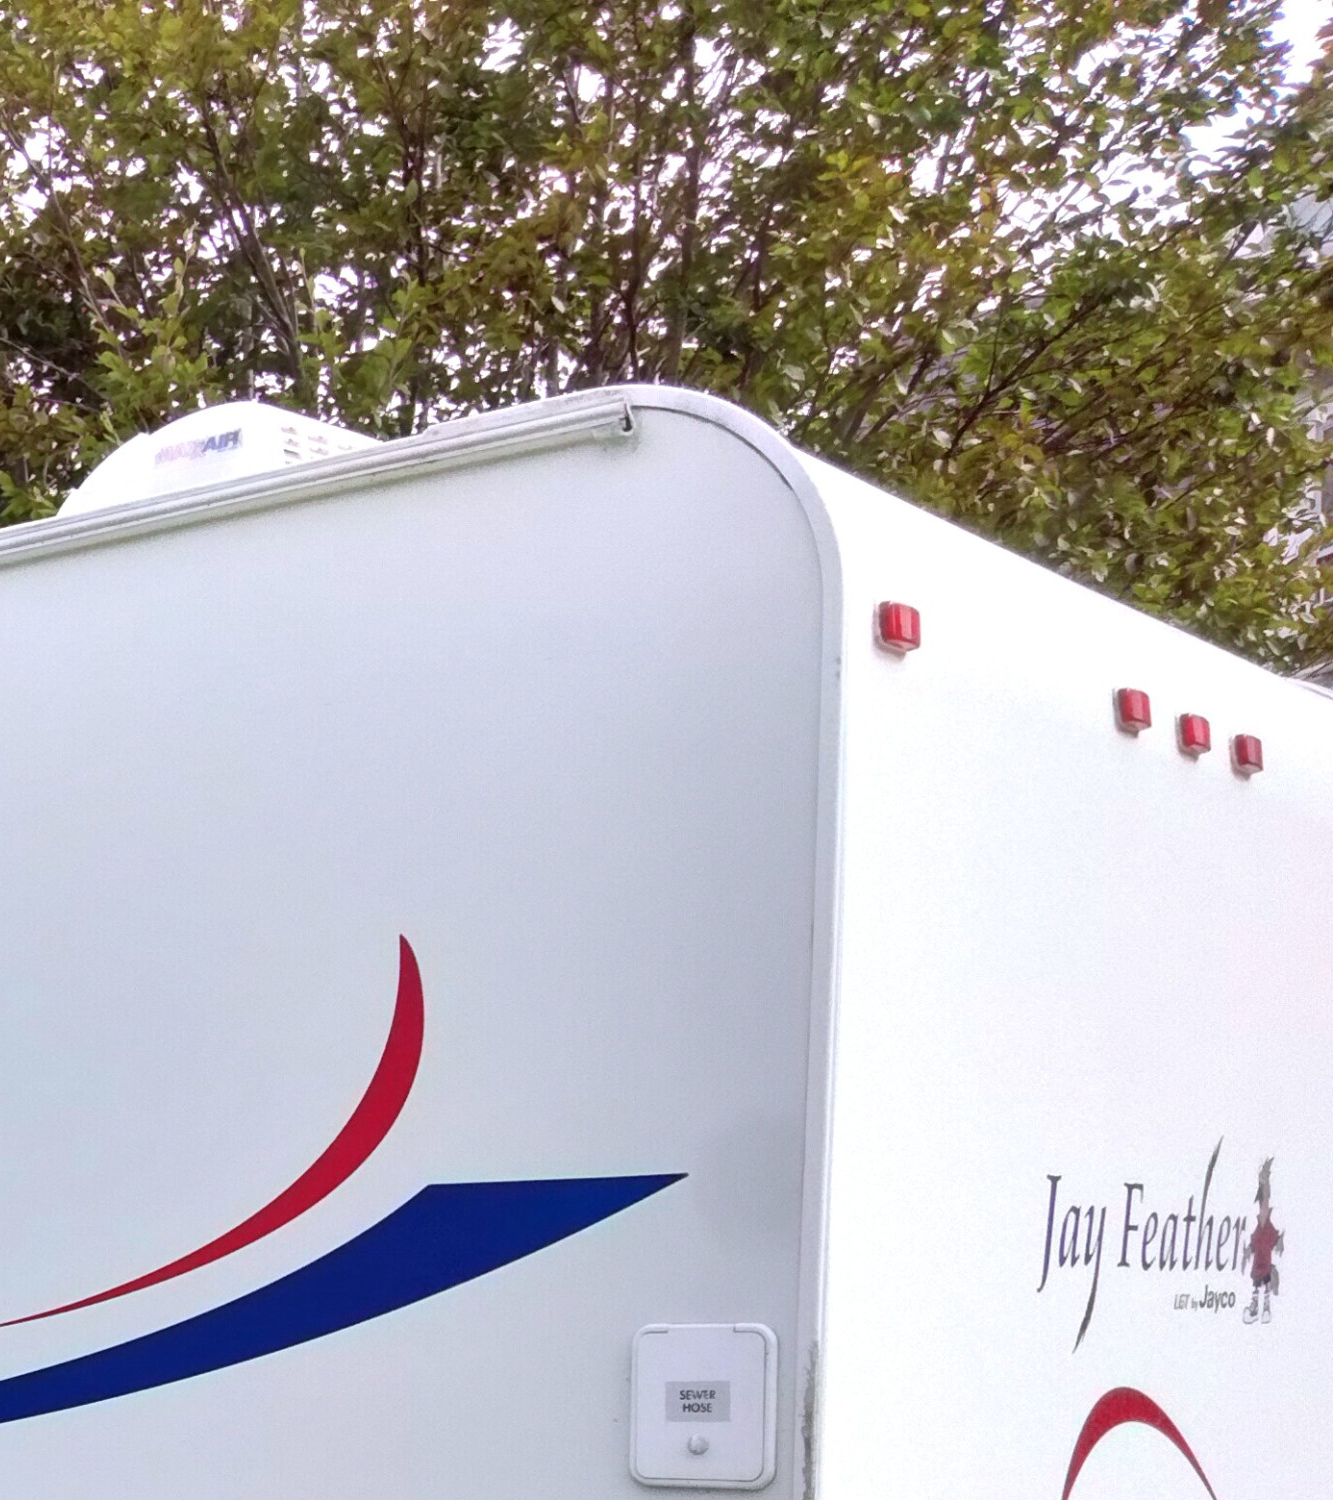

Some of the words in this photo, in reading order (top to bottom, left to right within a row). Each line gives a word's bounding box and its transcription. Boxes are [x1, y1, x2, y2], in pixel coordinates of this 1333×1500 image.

[1036, 1174, 1107, 1354] Jay
[1117, 1135, 1247, 1271] Feather
[1199, 1284, 1236, 1314] Jayco
[679, 1389, 717, 1401] SEWER
[682, 1403, 713, 1413] HOSE
